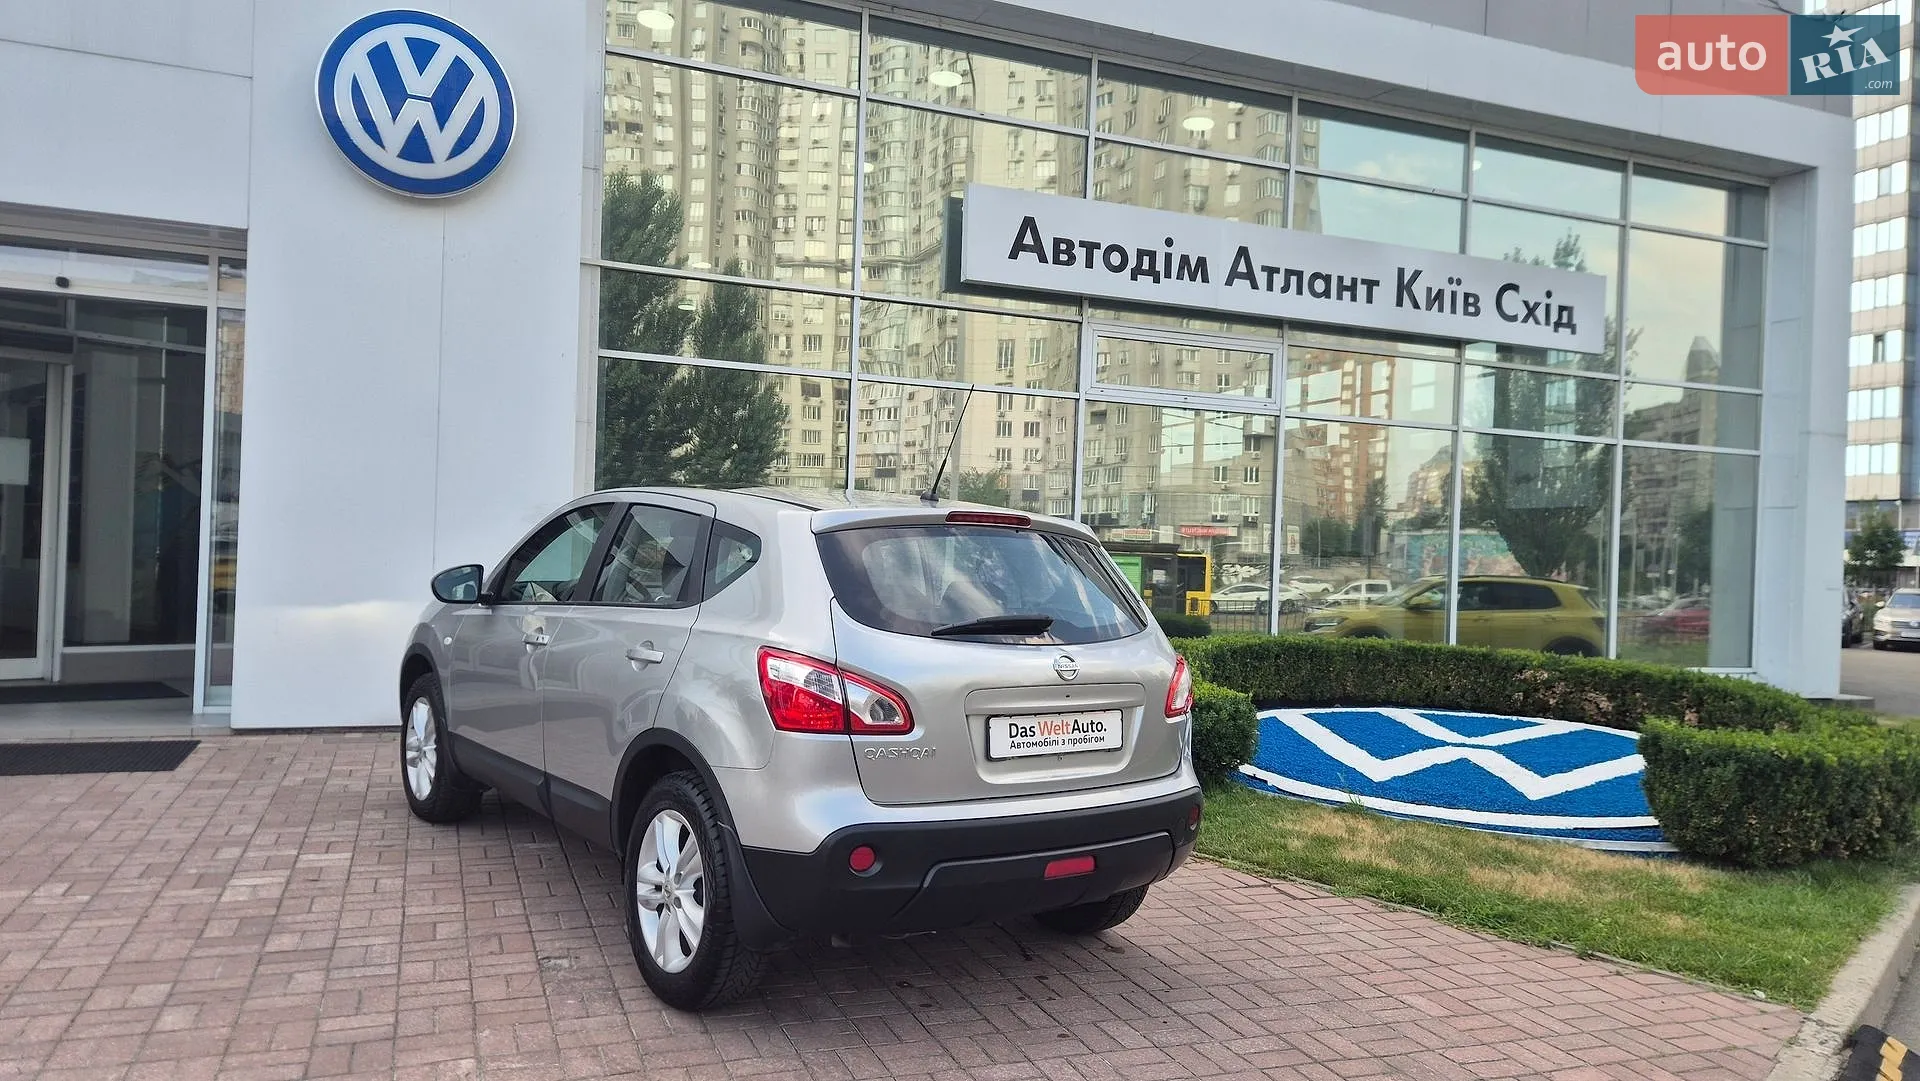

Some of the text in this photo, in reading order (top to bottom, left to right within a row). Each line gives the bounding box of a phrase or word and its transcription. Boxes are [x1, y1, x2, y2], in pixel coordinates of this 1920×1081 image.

[1007, 215, 1578, 336] Автодім Атлант Київ Схід
[1008, 722, 1036, 739] Das
[1009, 734, 1105, 750] Автомобілі з пробігом
[864, 747, 937, 761] QASHQAI
